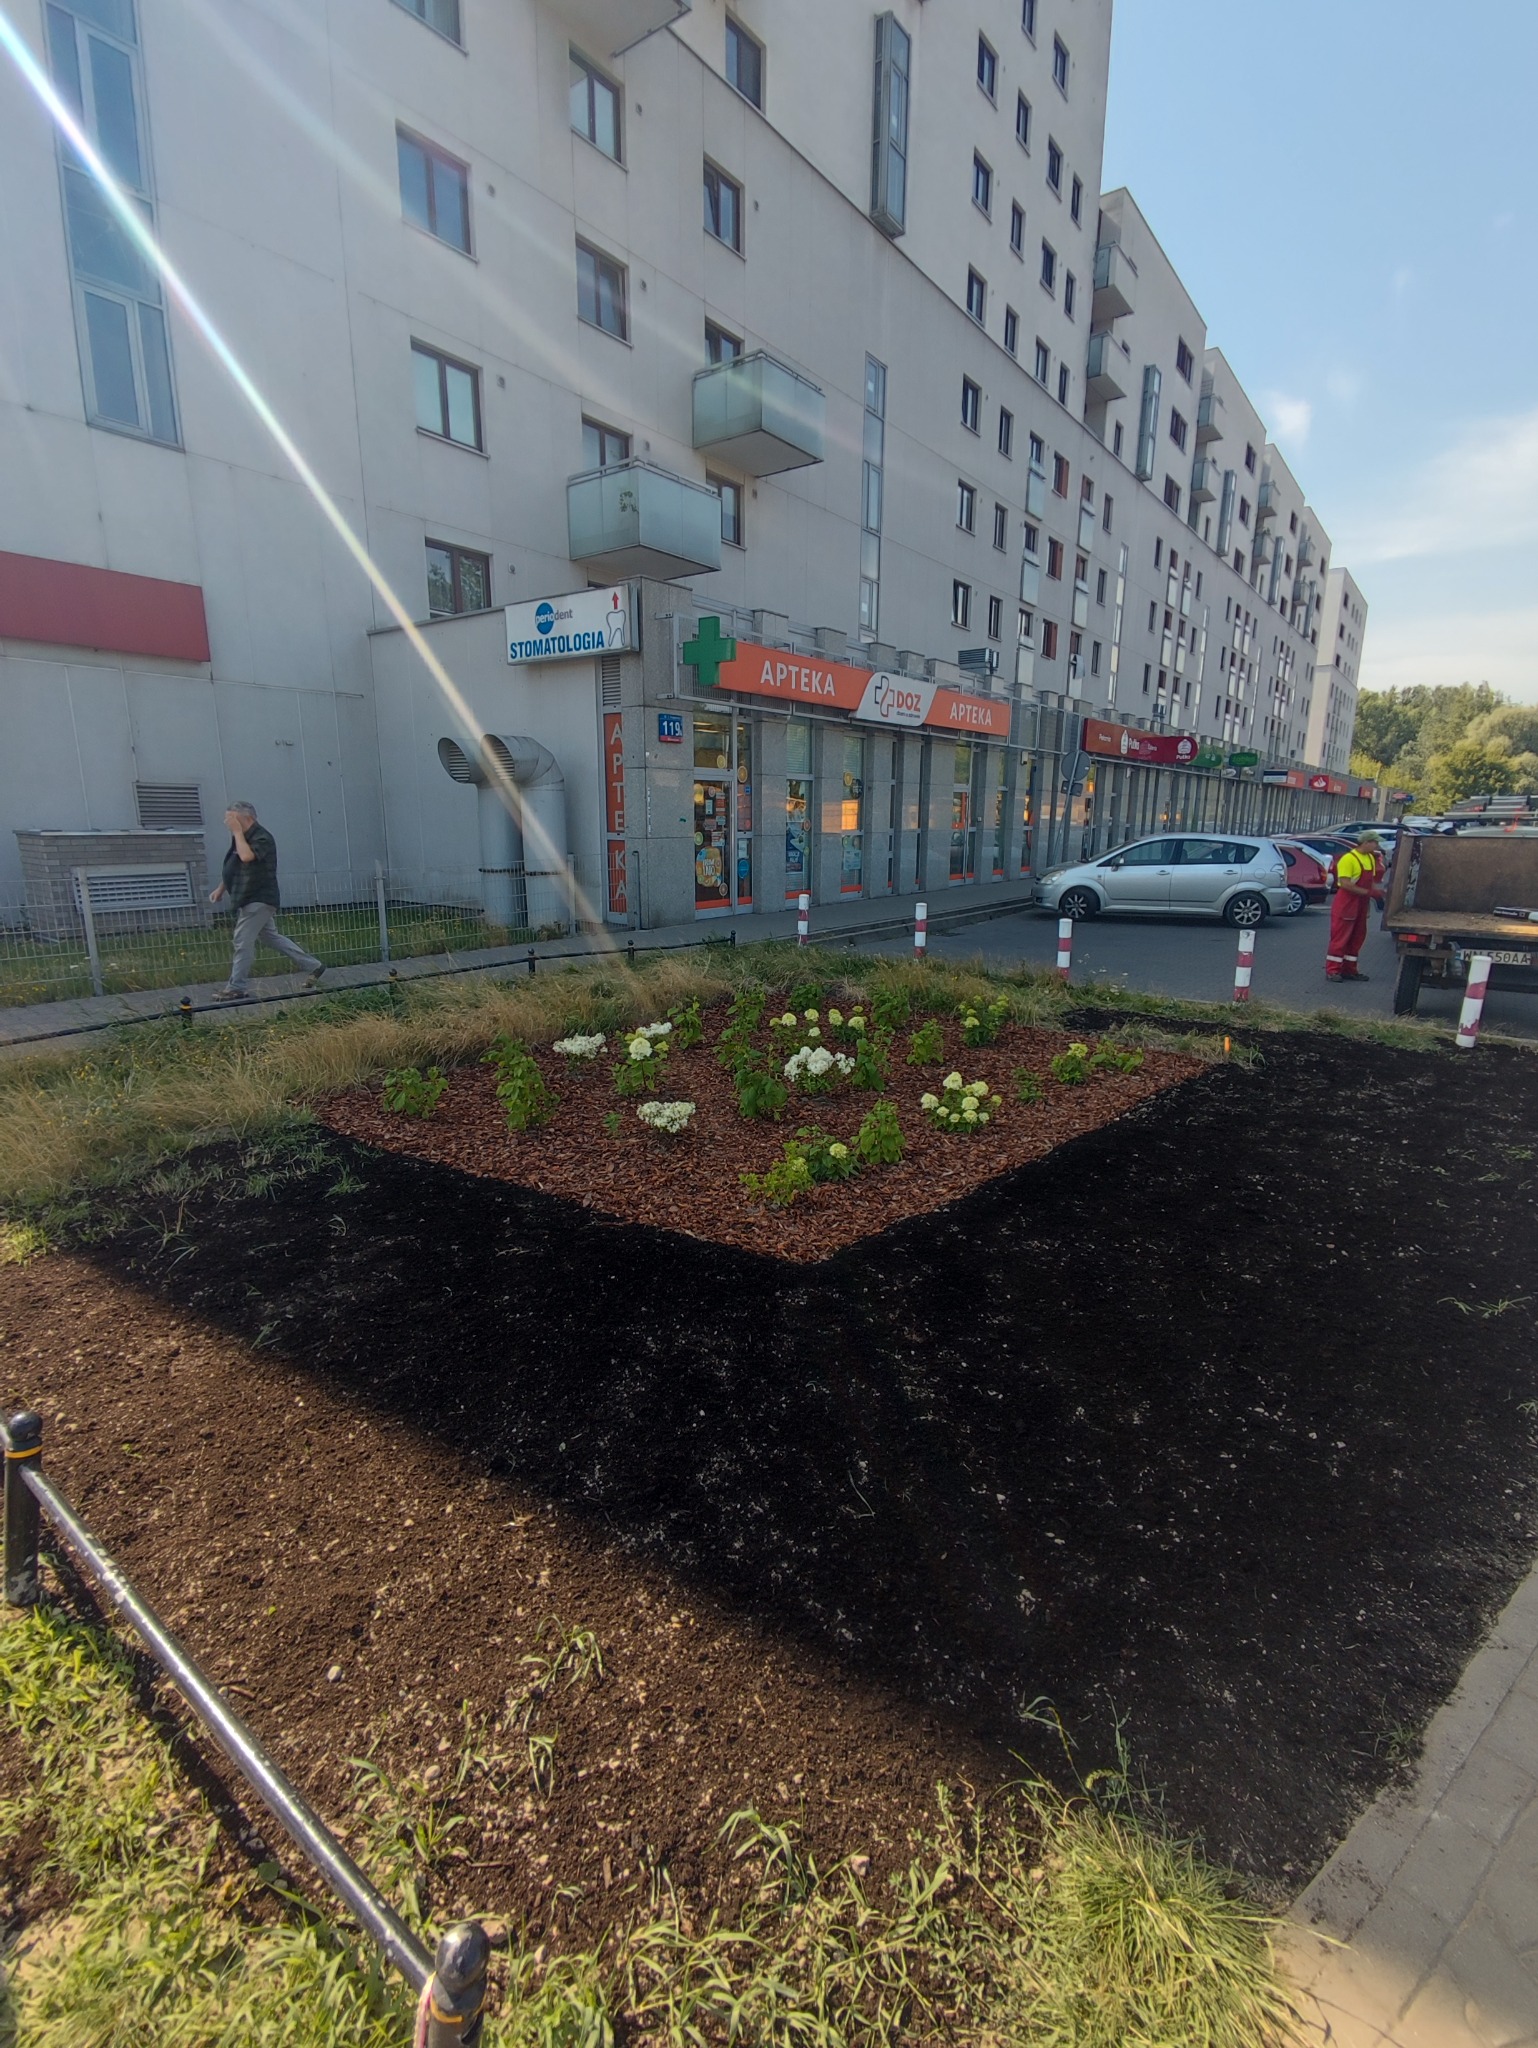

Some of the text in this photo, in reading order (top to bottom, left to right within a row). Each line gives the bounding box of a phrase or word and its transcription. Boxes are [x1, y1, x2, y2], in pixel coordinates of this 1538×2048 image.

[535, 608, 573, 626] periodent
[510, 630, 605, 659] STOMATOLOGIA
[760, 659, 836, 697] APTEKA
[896, 691, 922, 712] DOZ
[949, 702, 993, 726] APTEKA
[610, 722, 628, 900] APTEKA
